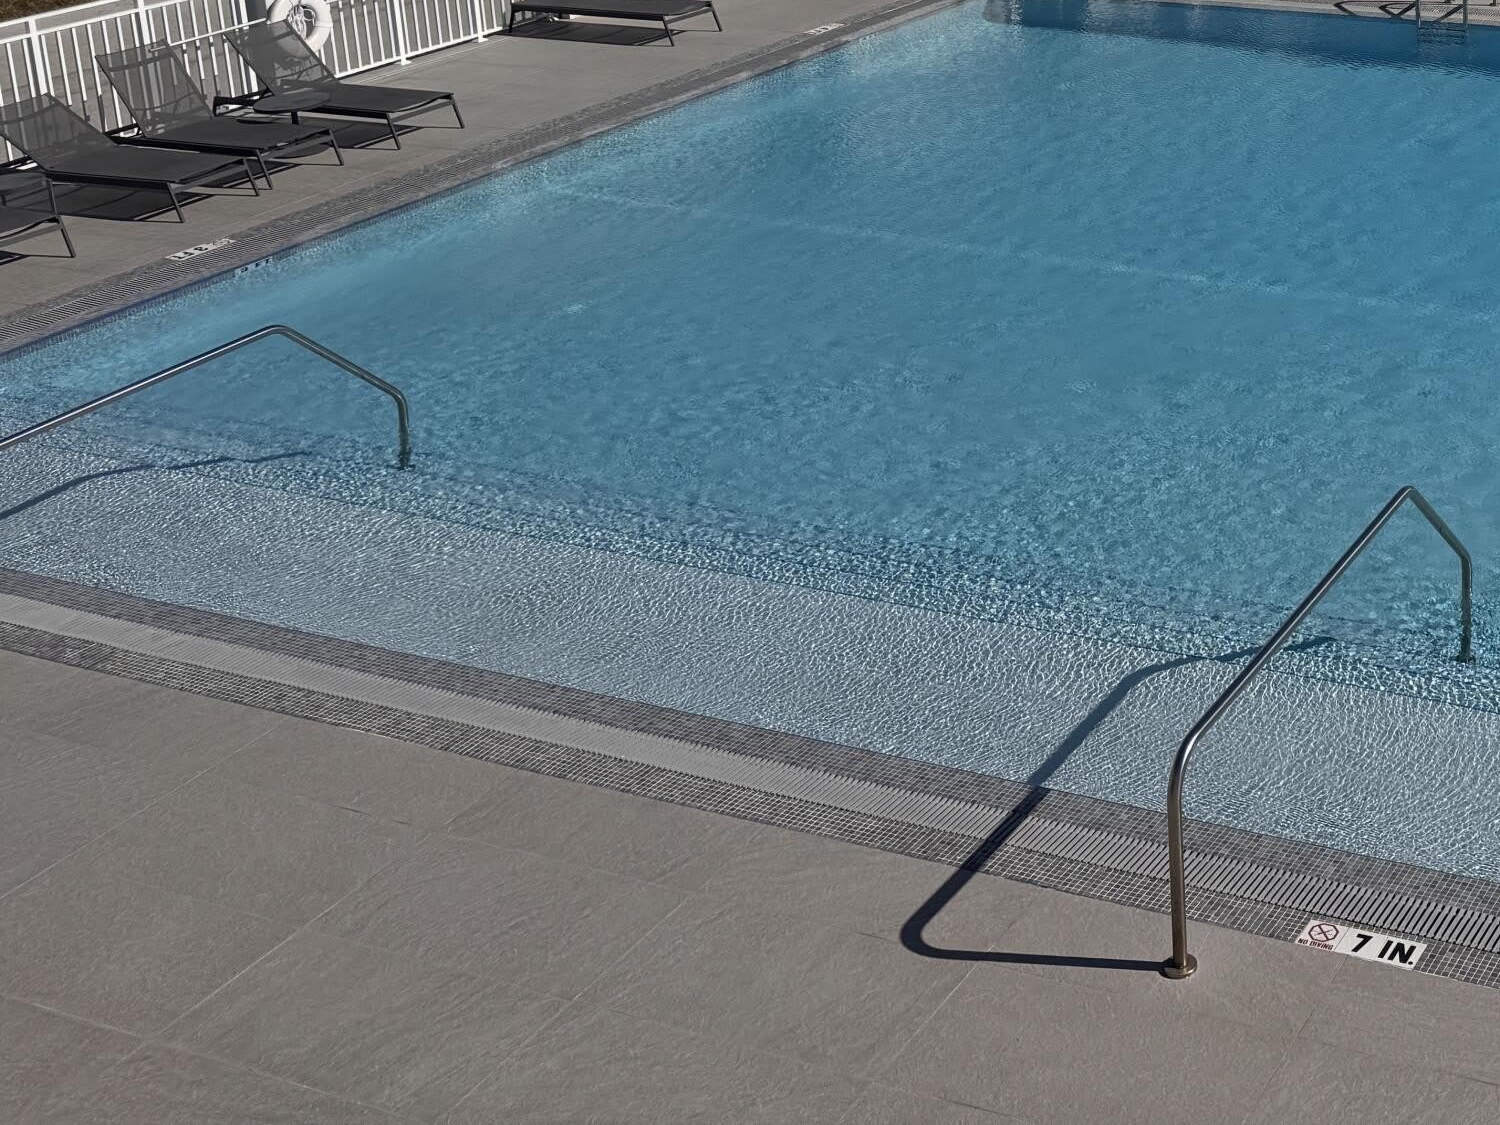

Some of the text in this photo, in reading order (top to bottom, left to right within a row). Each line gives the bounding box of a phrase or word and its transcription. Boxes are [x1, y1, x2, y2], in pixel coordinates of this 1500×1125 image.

[1310, 941, 1334, 951] DIVING
[1351, 933, 1416, 966] 7 IN.
